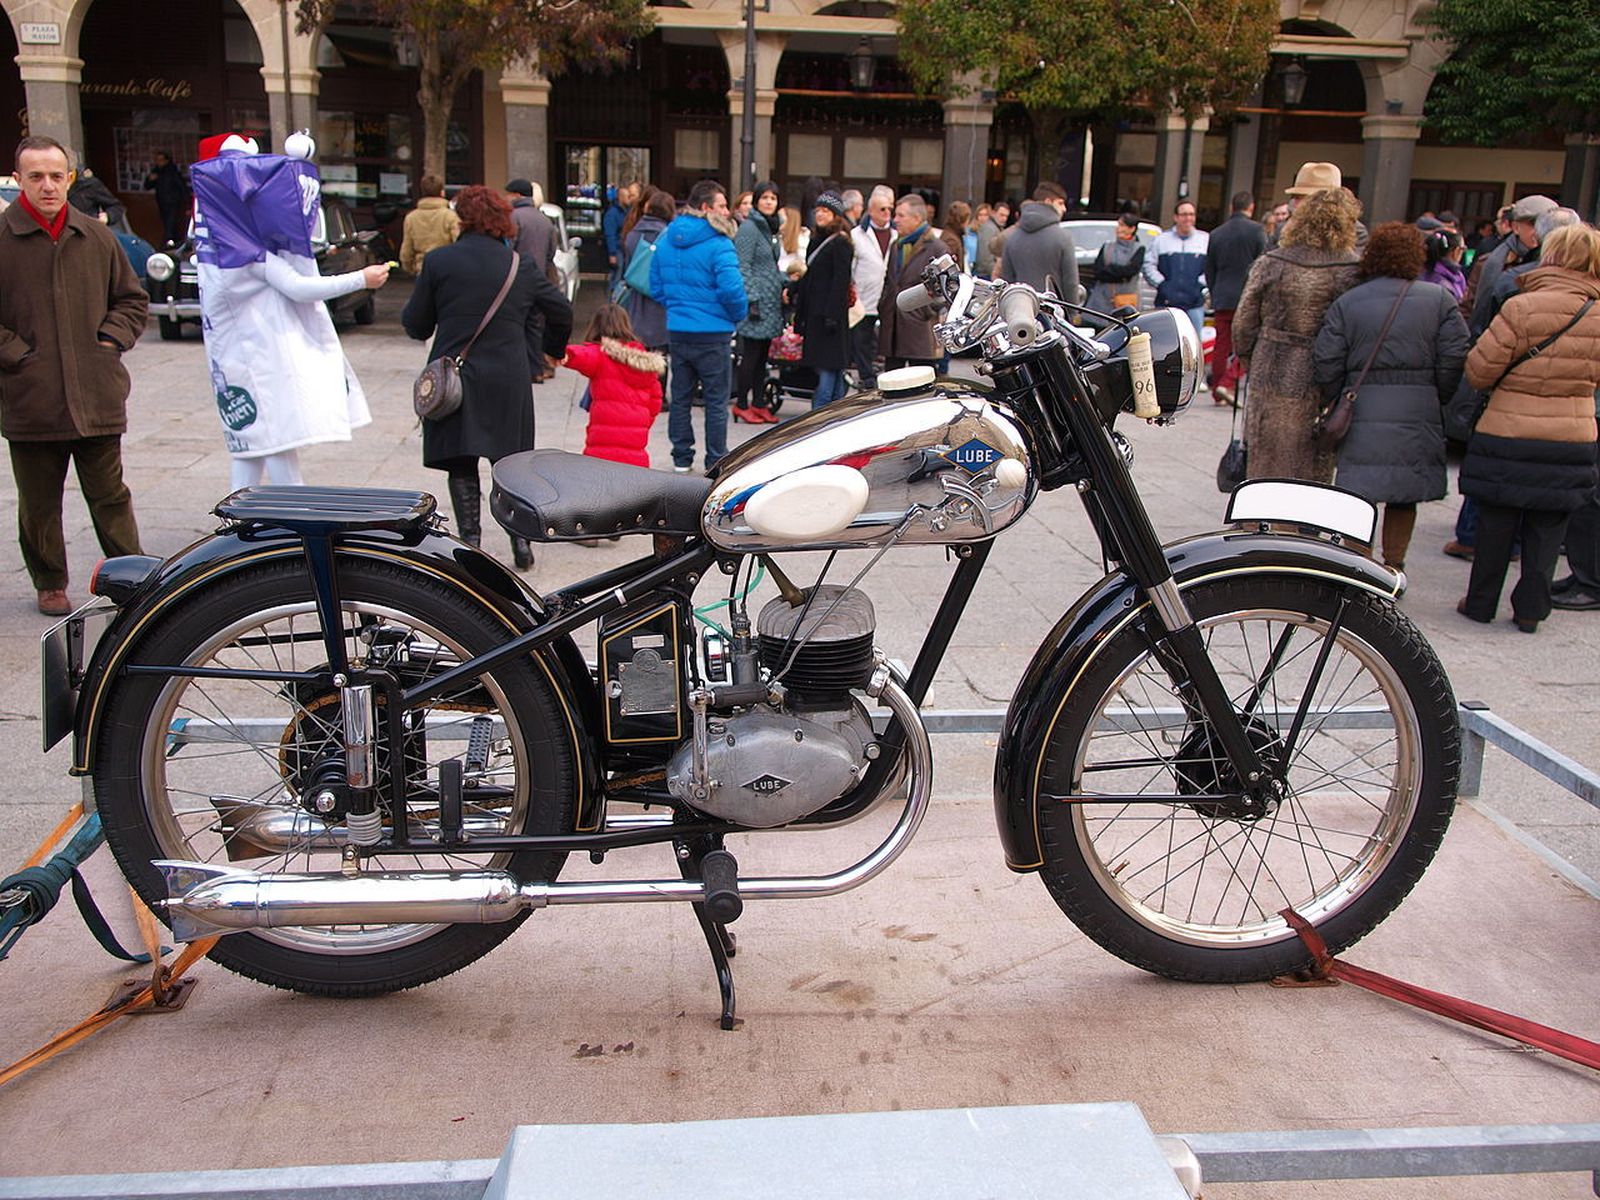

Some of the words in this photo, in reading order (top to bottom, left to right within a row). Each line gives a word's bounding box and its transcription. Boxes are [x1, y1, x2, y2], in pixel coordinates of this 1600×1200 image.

[1135, 378, 1154, 395] 96
[220, 402, 255, 426] bien
[956, 449, 994, 463] LUBE
[753, 780, 781, 791] LUBE
